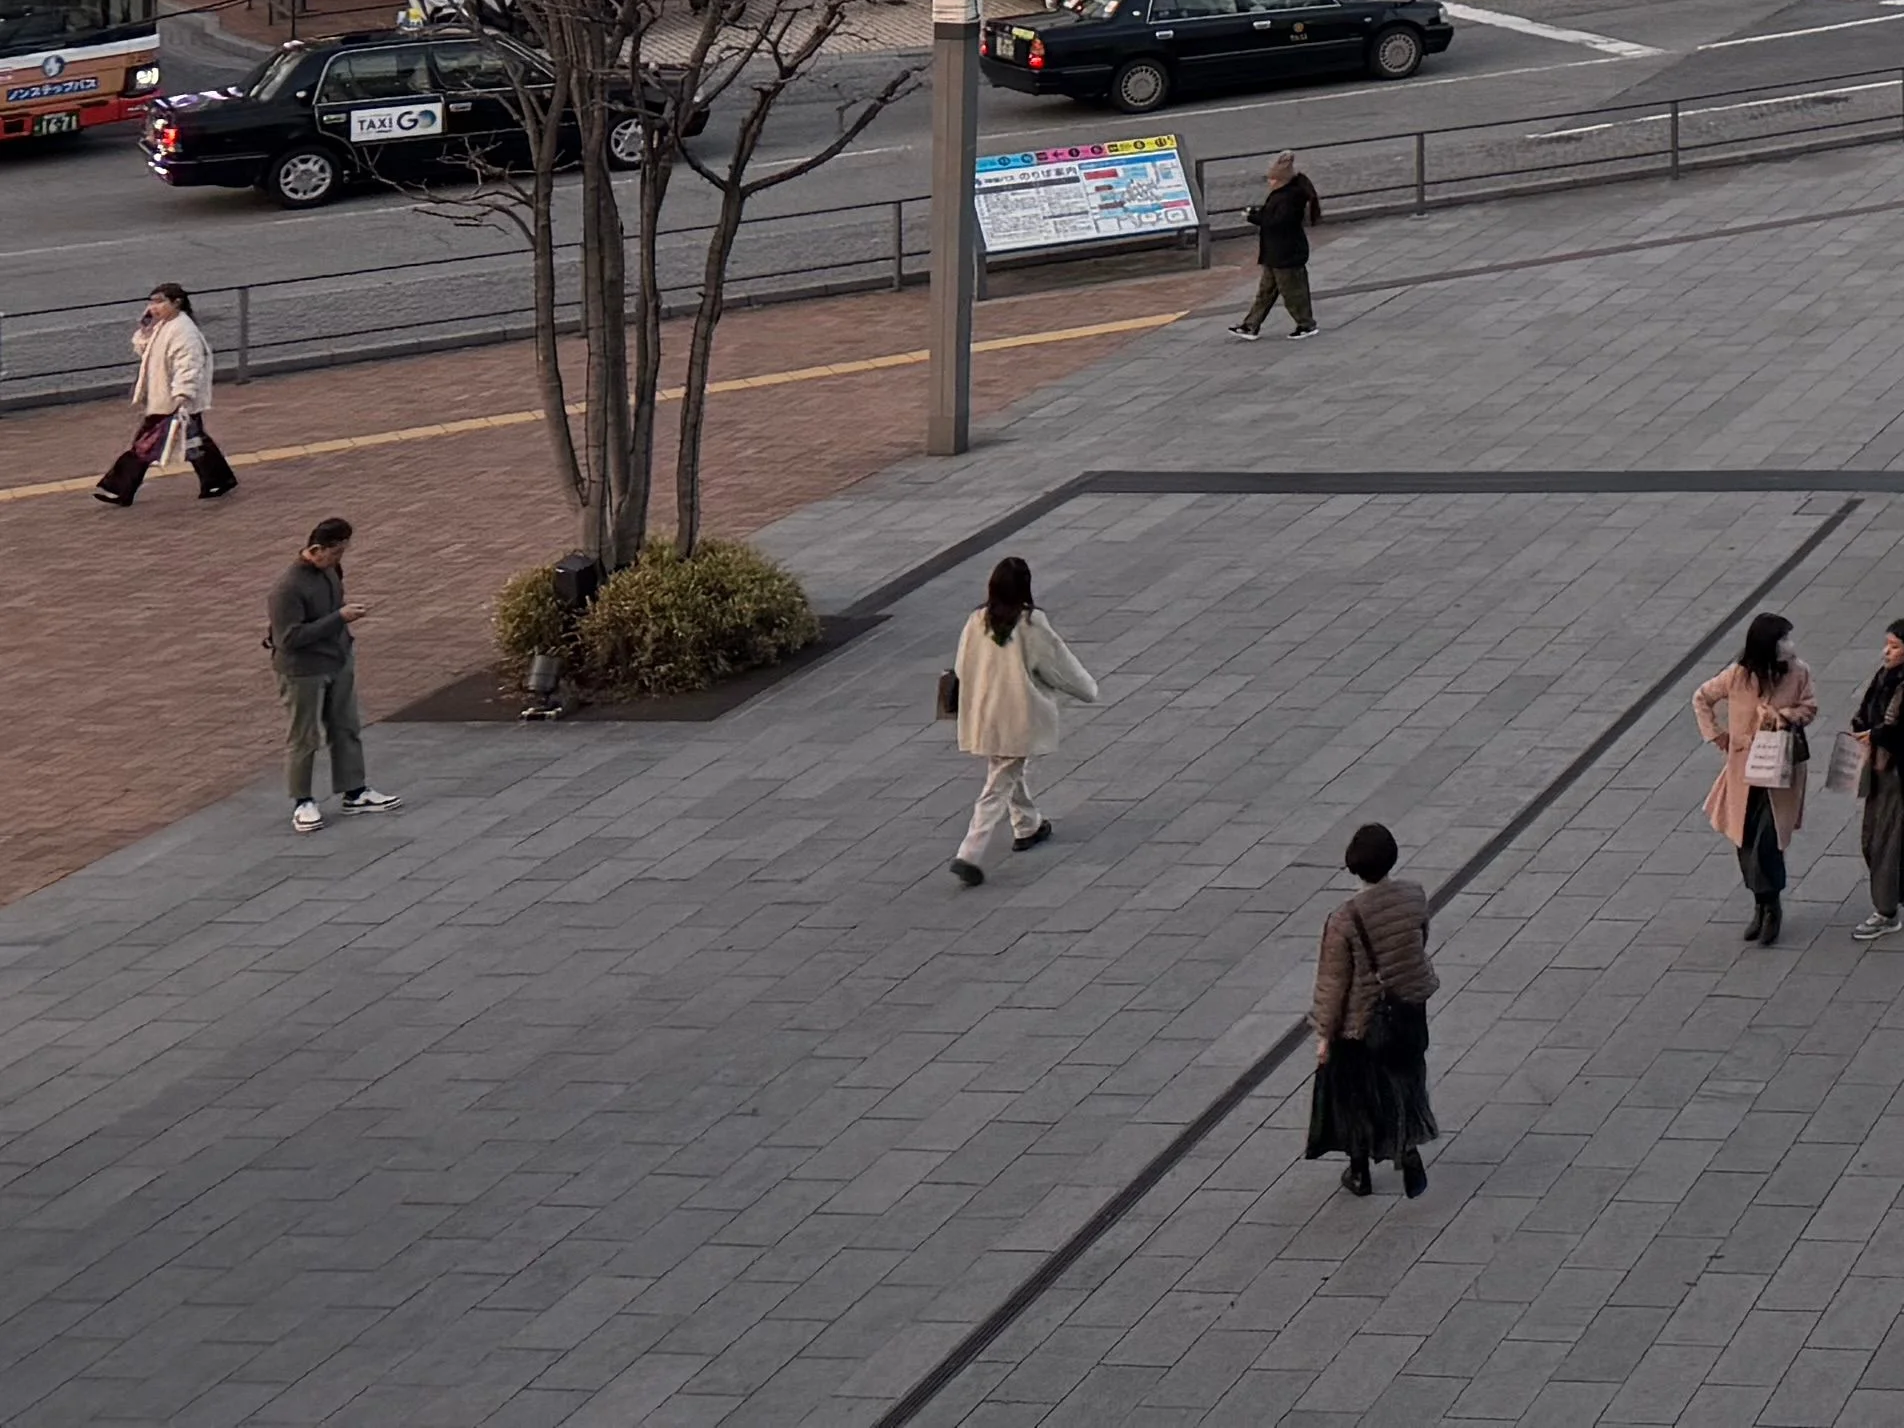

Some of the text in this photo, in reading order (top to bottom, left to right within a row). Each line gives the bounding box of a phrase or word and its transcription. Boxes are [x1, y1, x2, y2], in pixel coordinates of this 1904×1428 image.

[8, 78, 98, 102] ノンステップバス
[357, 117, 393, 131] TAXI
